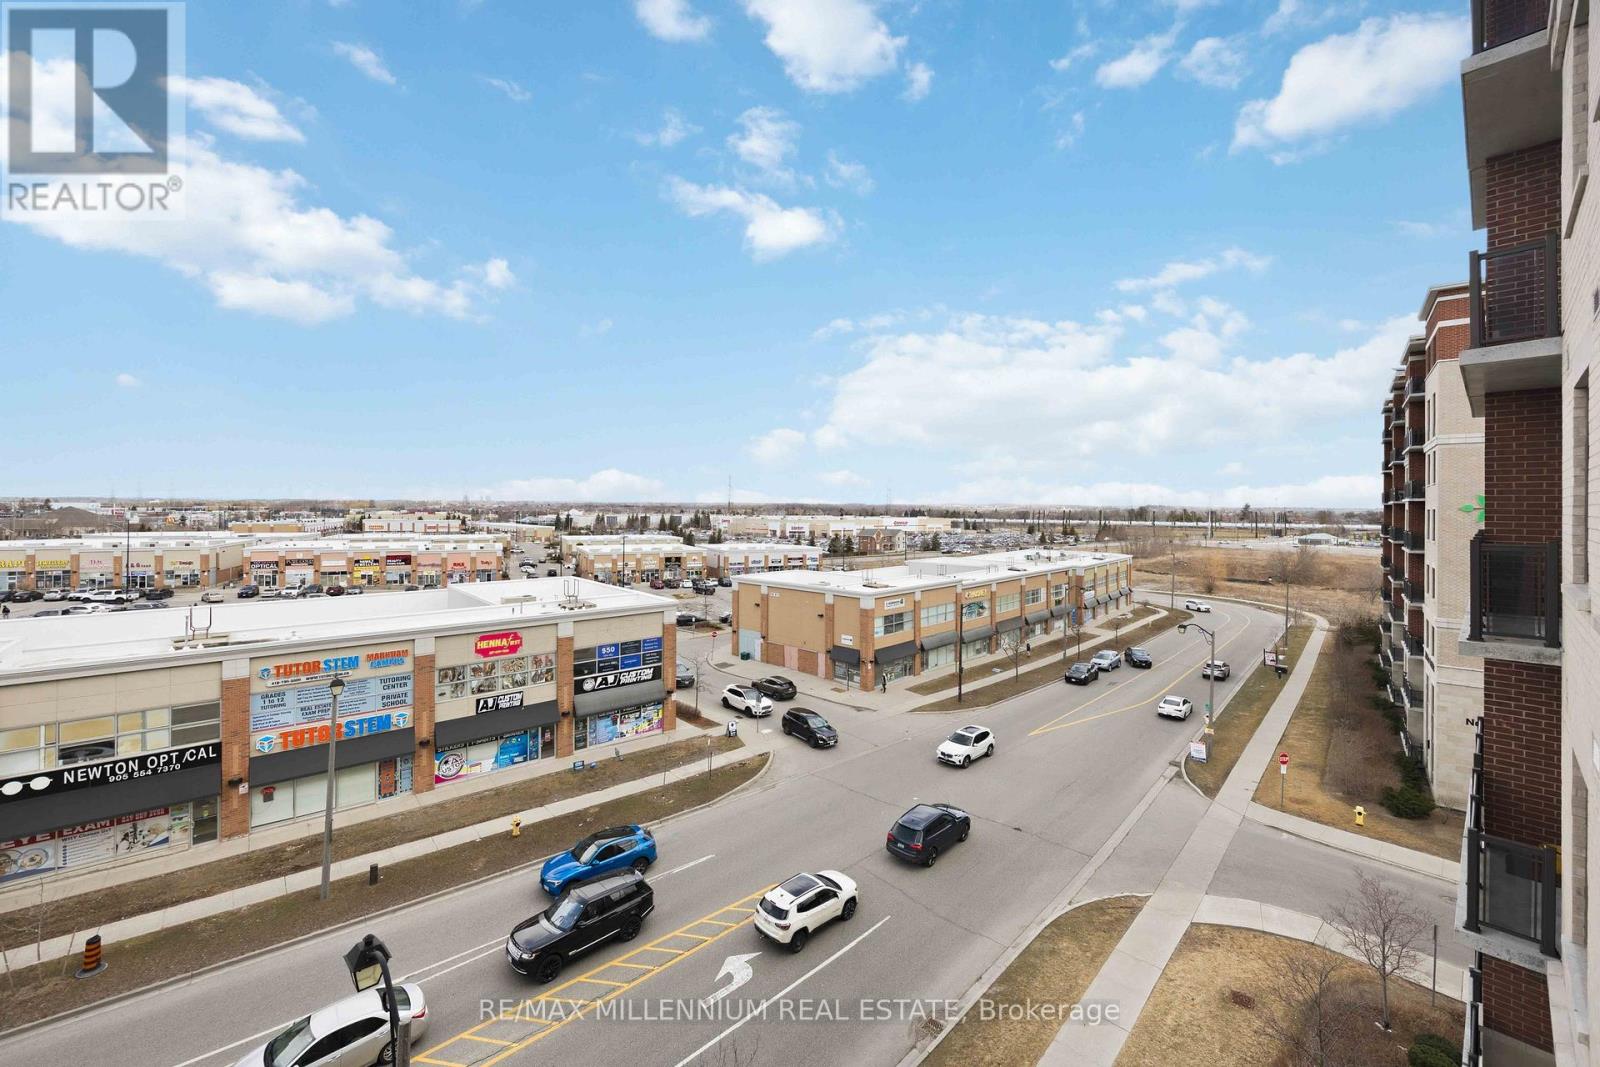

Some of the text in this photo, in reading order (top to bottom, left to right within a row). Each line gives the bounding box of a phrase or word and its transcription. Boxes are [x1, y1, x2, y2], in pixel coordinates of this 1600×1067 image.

[477, 638, 507, 650] HENNA
[620, 667, 654, 679] CUSTOM
[380, 674, 411, 685] TUTORING
[620, 674, 653, 685] PRINTING
[382, 682, 408, 691] CENTER
[261, 691, 287, 700] GRADES
[381, 692, 409, 701] PRIVATE
[498, 691, 522, 703] CUSTOM
[260, 702, 287, 711] TUTORING
[381, 699, 407, 708] SCHOOL
[317, 707, 331, 715] PREP
[63, 759, 140, 785] NEWTON
[108, 773, 129, 783] 905
[62, 819, 111, 836] EXAM
